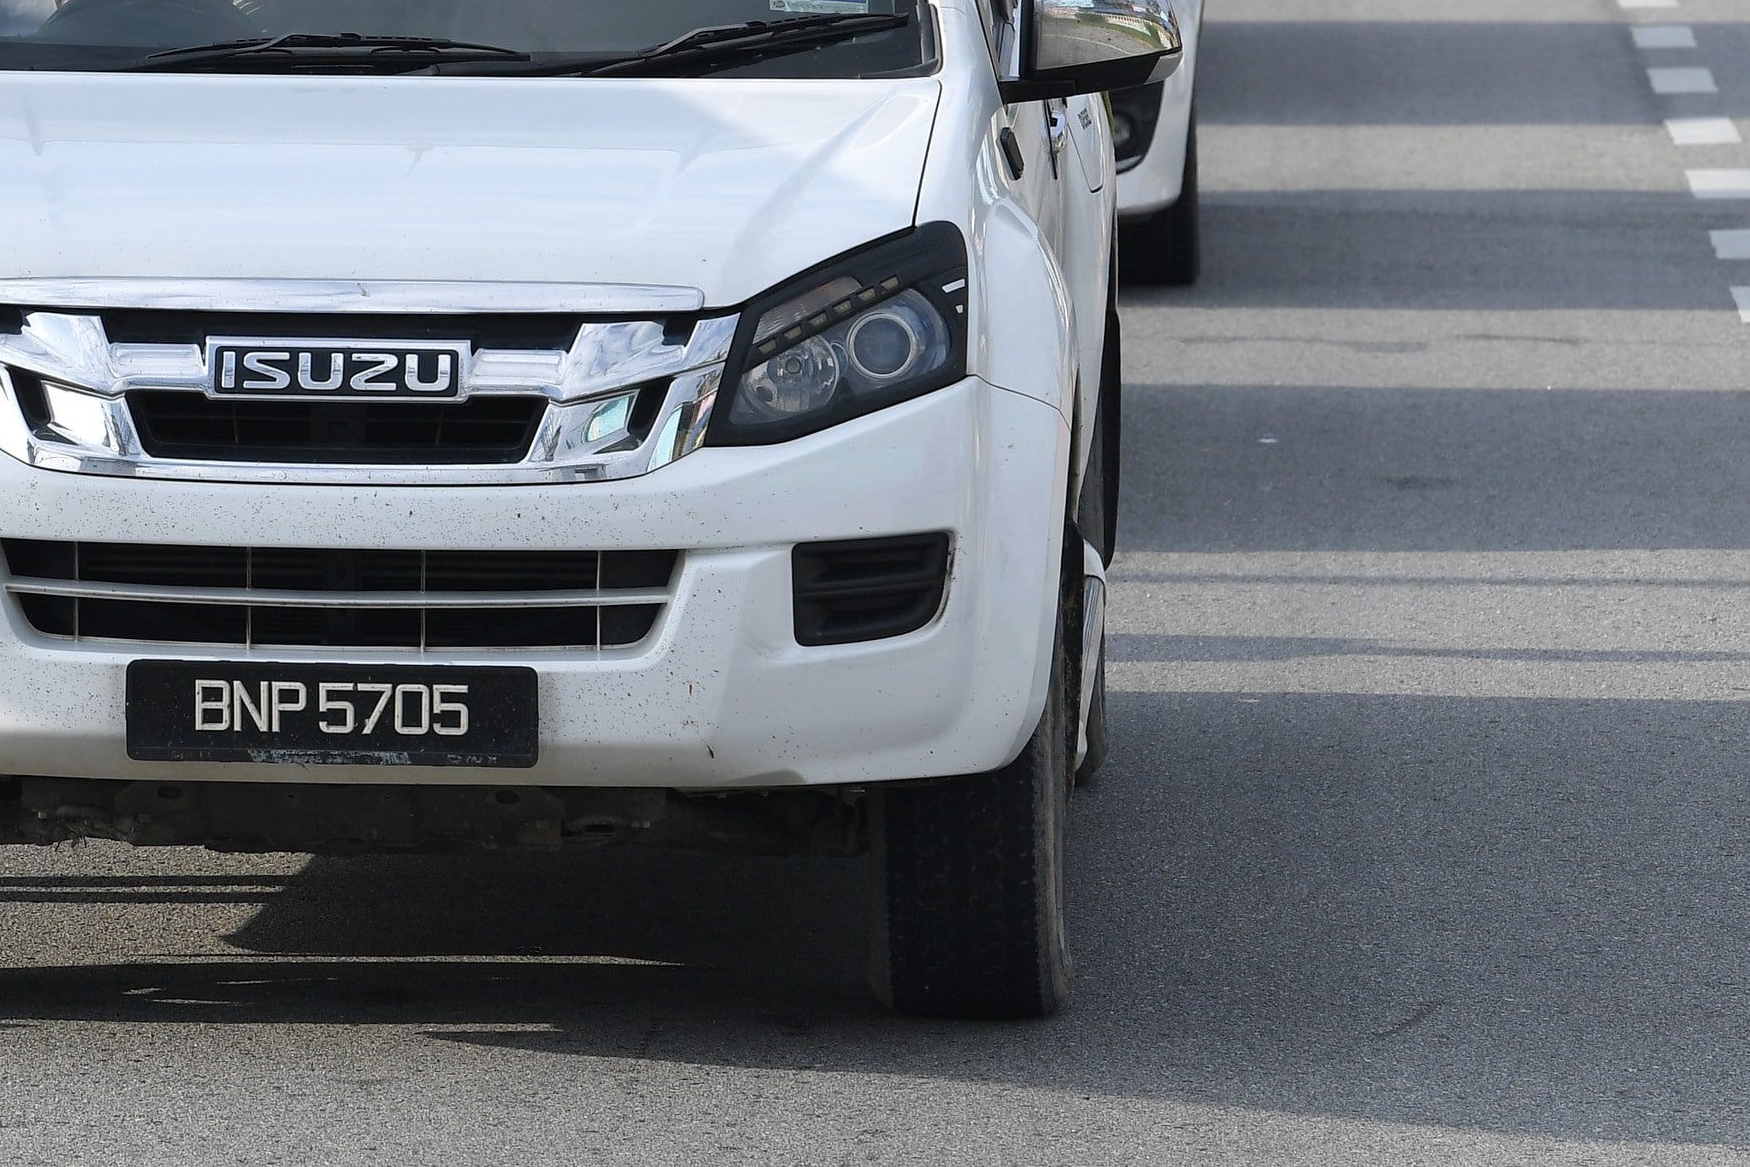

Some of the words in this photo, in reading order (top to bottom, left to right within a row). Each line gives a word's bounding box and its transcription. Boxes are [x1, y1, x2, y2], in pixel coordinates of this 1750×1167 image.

[221, 351, 451, 391] ISUZU
[195, 678, 307, 733] BNP
[318, 682, 469, 736] 5705
